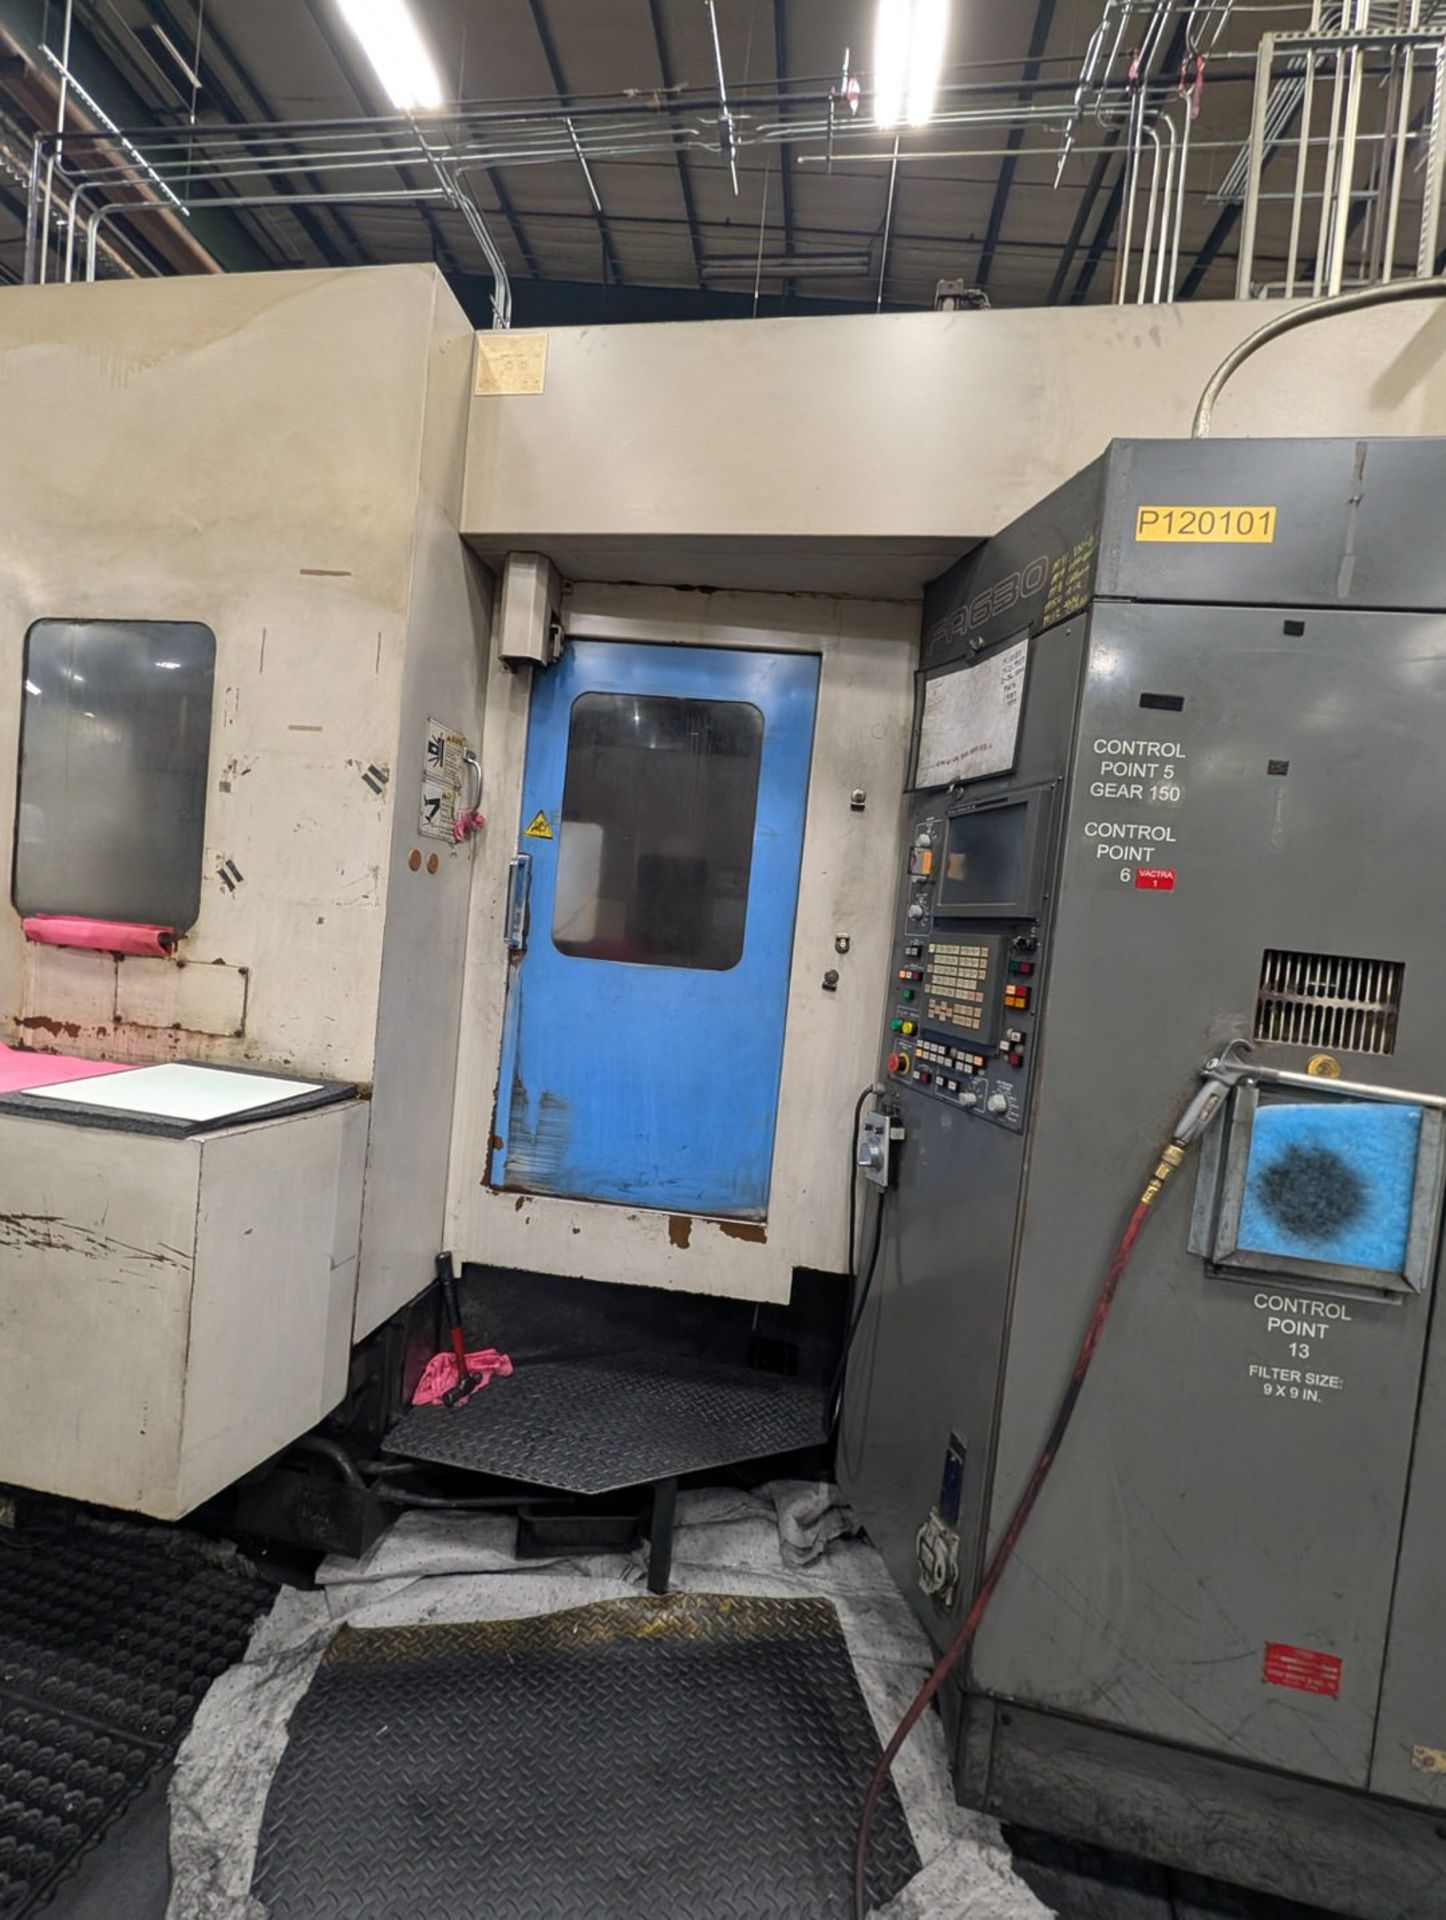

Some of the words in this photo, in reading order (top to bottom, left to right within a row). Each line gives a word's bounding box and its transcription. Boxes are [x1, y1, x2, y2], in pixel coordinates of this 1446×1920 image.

[1138, 510, 1270, 535] P120101
[1093, 738, 1186, 758] CONTROL
[1100, 761, 1159, 778] POINT
[1163, 764, 1175, 779] 5
[1090, 782, 1143, 800] GEAR
[1149, 786, 1181, 802] 150
[1084, 822, 1177, 842] CONTROL
[1096, 844, 1155, 862] POINT
[1119, 867, 1131, 882] 6
[1254, 1293, 1352, 1321] CONTROL
[1267, 1316, 1330, 1340] POINT
[1288, 1342, 1310, 1359] 13
[1249, 1364, 1302, 1383] FILTER
[1305, 1372, 1344, 1389] SIZE:
[1263, 1383, 1273, 1395] 9
[1275, 1384, 1286, 1397] X
[1289, 1386, 1299, 1399] 9
[1302, 1388, 1322, 1403] IN.
